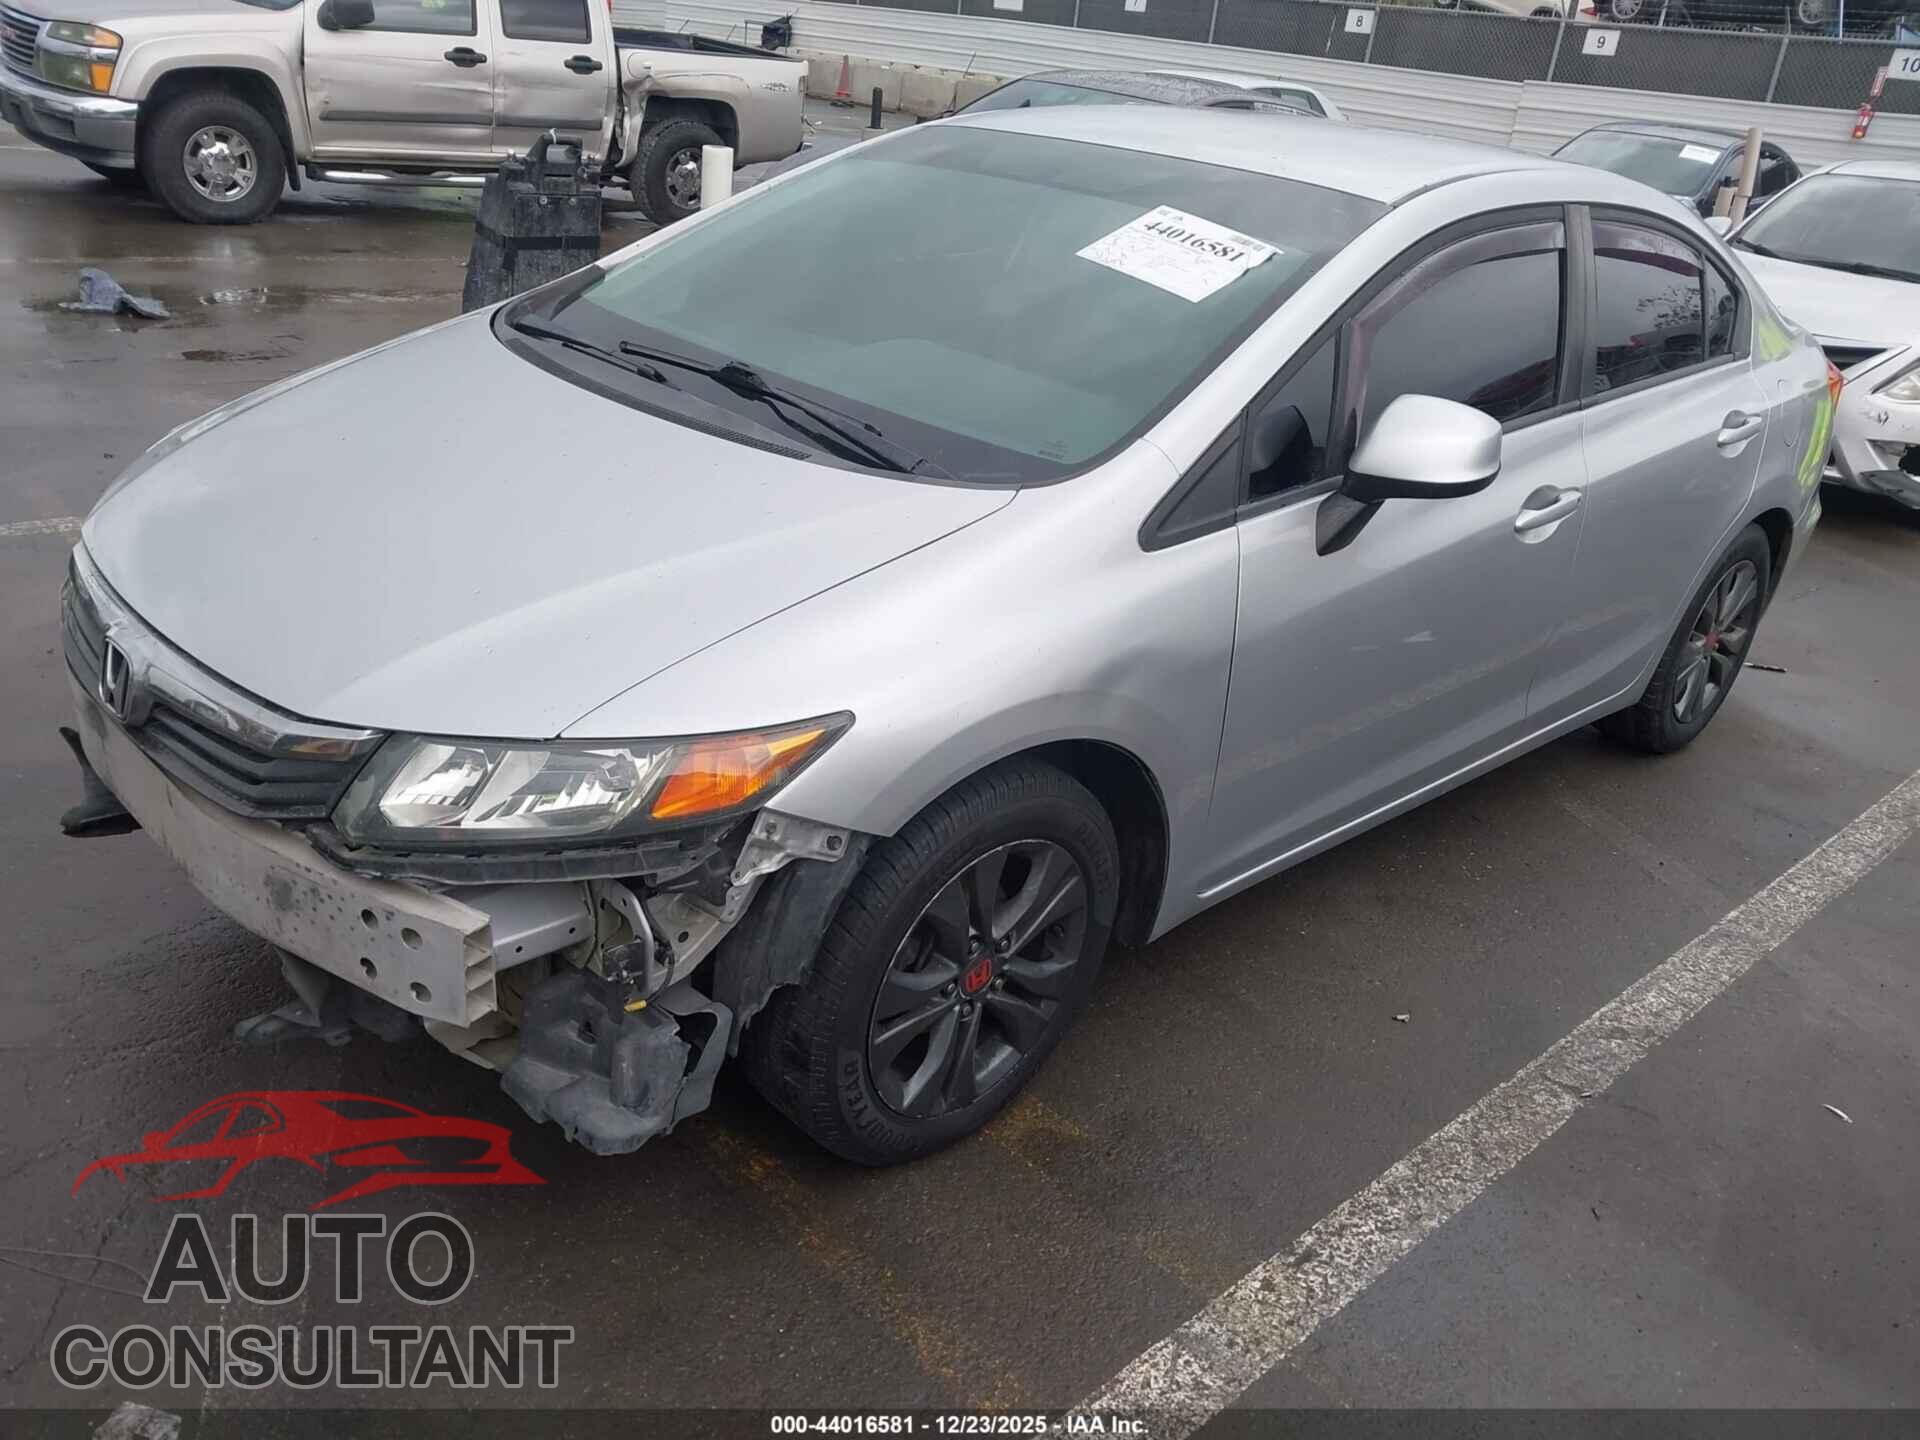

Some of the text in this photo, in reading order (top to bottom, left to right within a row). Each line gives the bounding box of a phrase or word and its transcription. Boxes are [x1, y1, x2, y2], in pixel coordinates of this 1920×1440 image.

[1355, 15, 1364, 28] 8
[1597, 35, 1606, 49] 9
[1902, 57, 1920, 73] 10
[1143, 221, 1245, 262] 44016581
